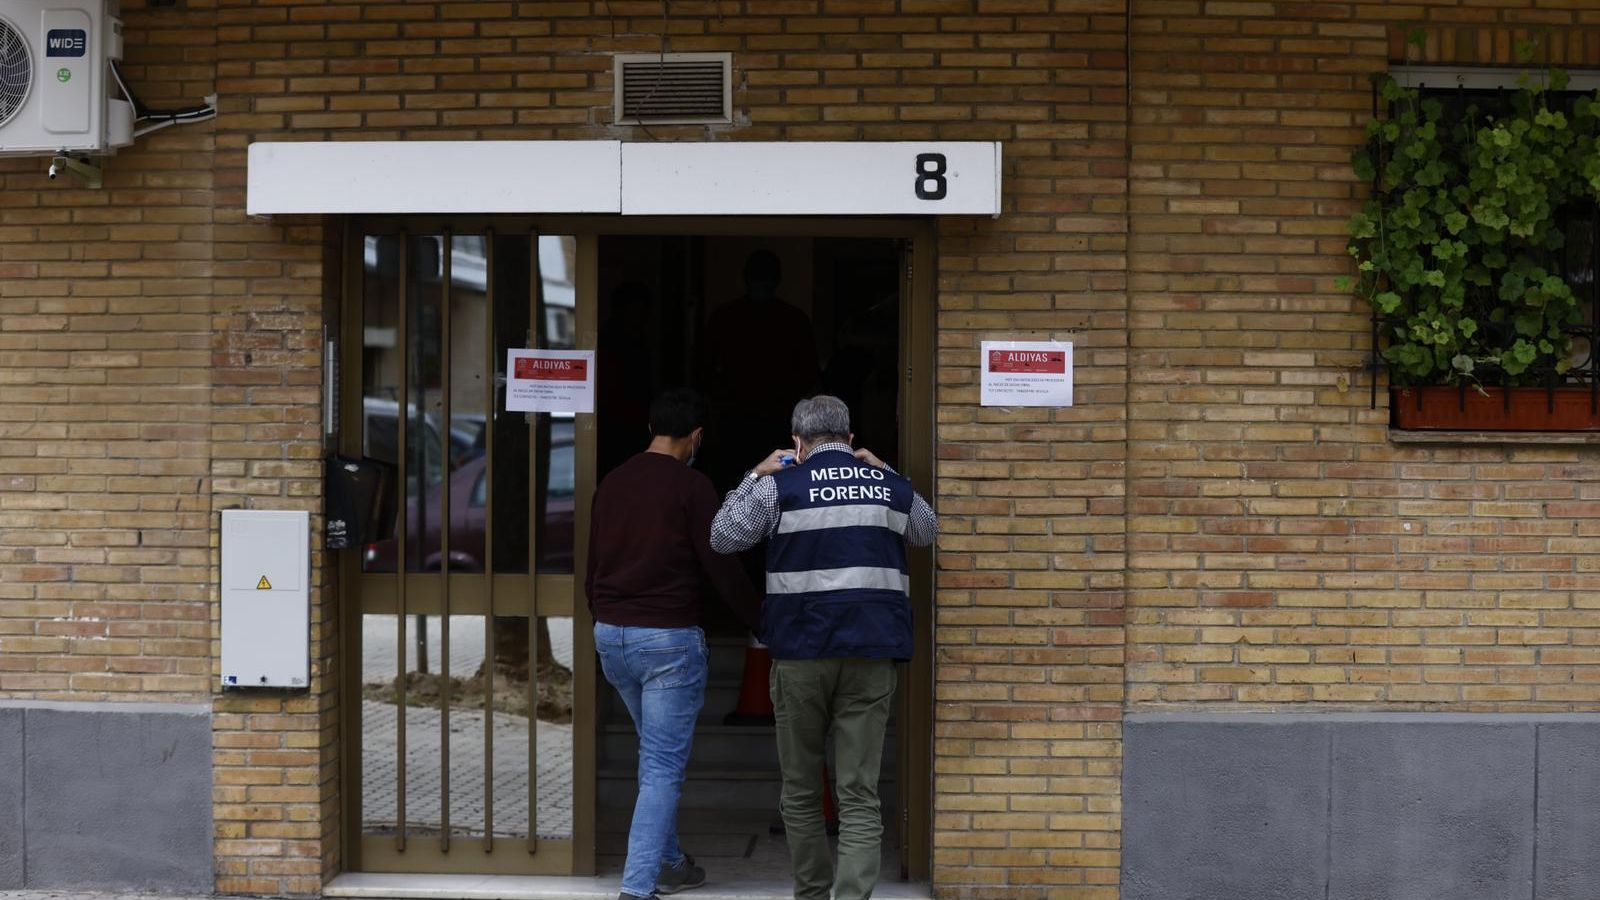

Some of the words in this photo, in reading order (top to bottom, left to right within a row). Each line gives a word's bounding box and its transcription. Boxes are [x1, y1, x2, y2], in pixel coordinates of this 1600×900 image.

[50, 38, 83, 49] WIDE
[914, 153, 948, 201] 8
[1008, 352, 1048, 362] ALDIYAS
[533, 360, 571, 370] ALDIYAS
[811, 467, 885, 481] MEDICO
[809, 485, 892, 502] FORENSE
